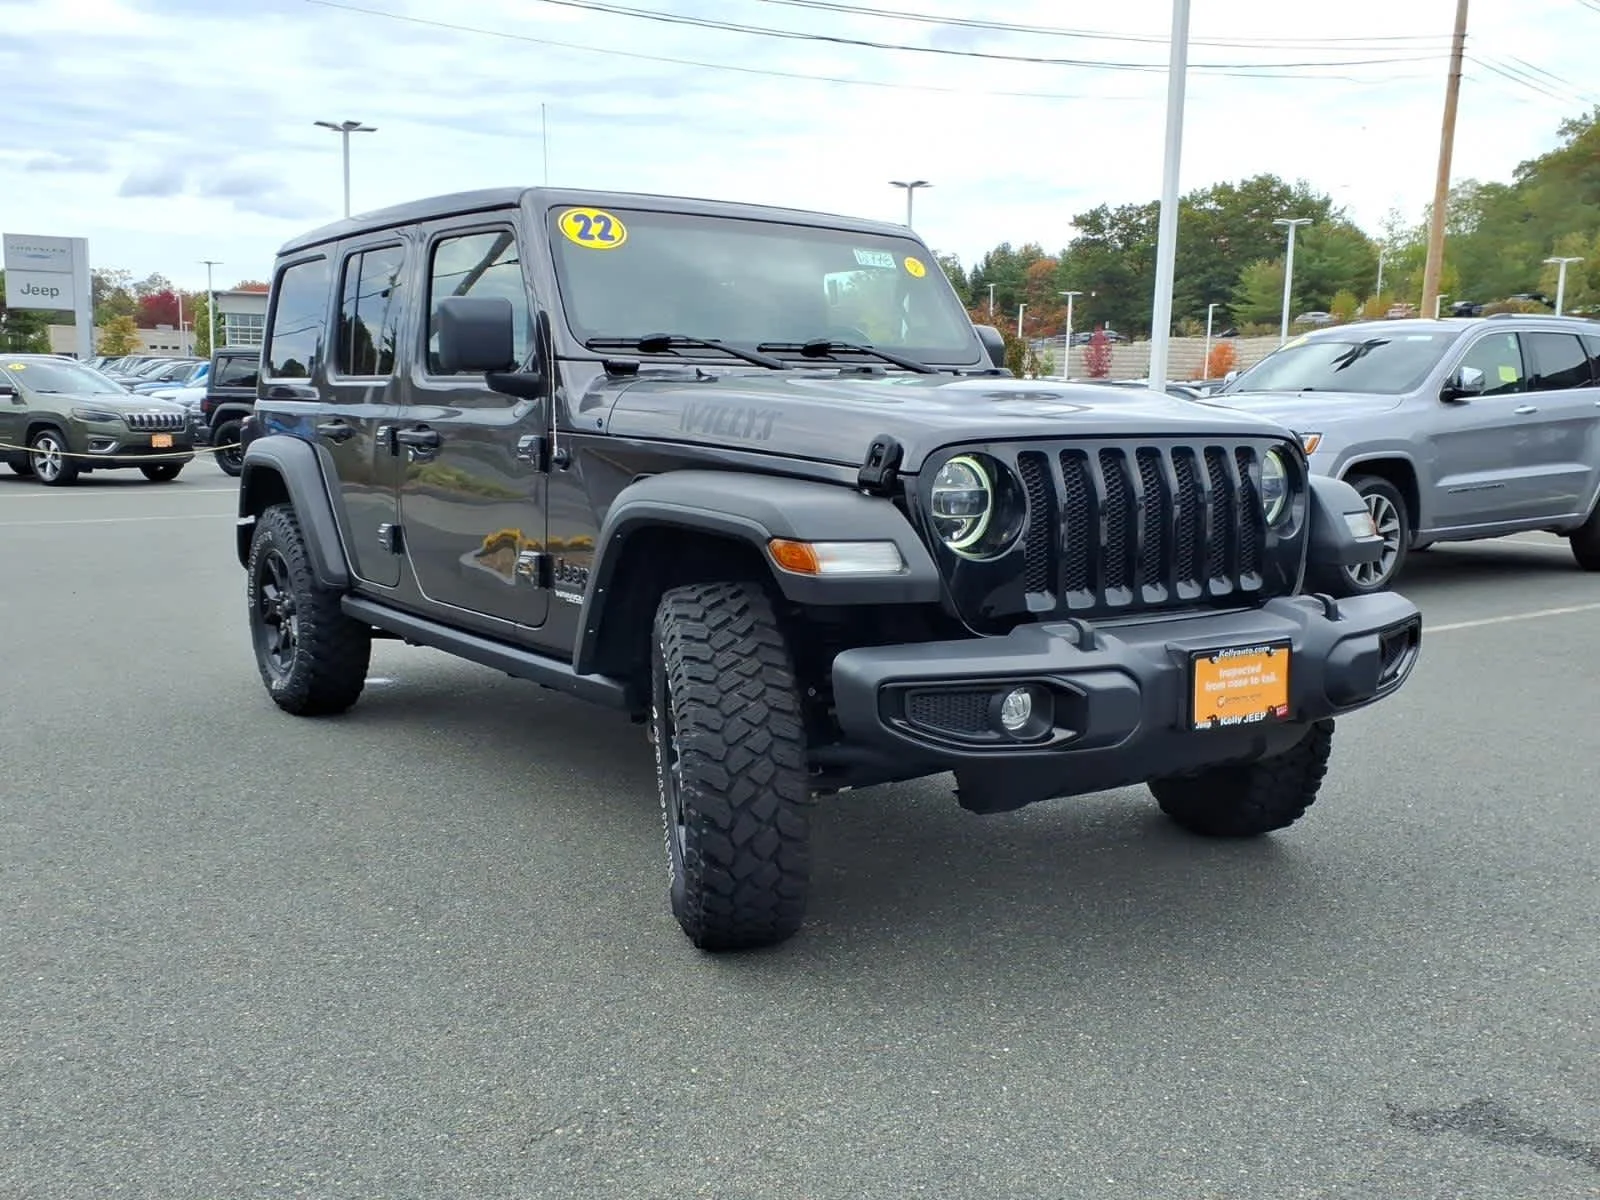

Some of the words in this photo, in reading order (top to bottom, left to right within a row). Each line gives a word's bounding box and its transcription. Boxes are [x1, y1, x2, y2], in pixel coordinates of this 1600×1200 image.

[573, 214, 616, 241] 22
[20, 283, 60, 300] Jeep
[553, 557, 589, 586] Jeep
[1218, 646, 1271, 658] Kellyauto.com
[1220, 715, 1242, 726] Kelly
[1243, 711, 1267, 724] JEEP
